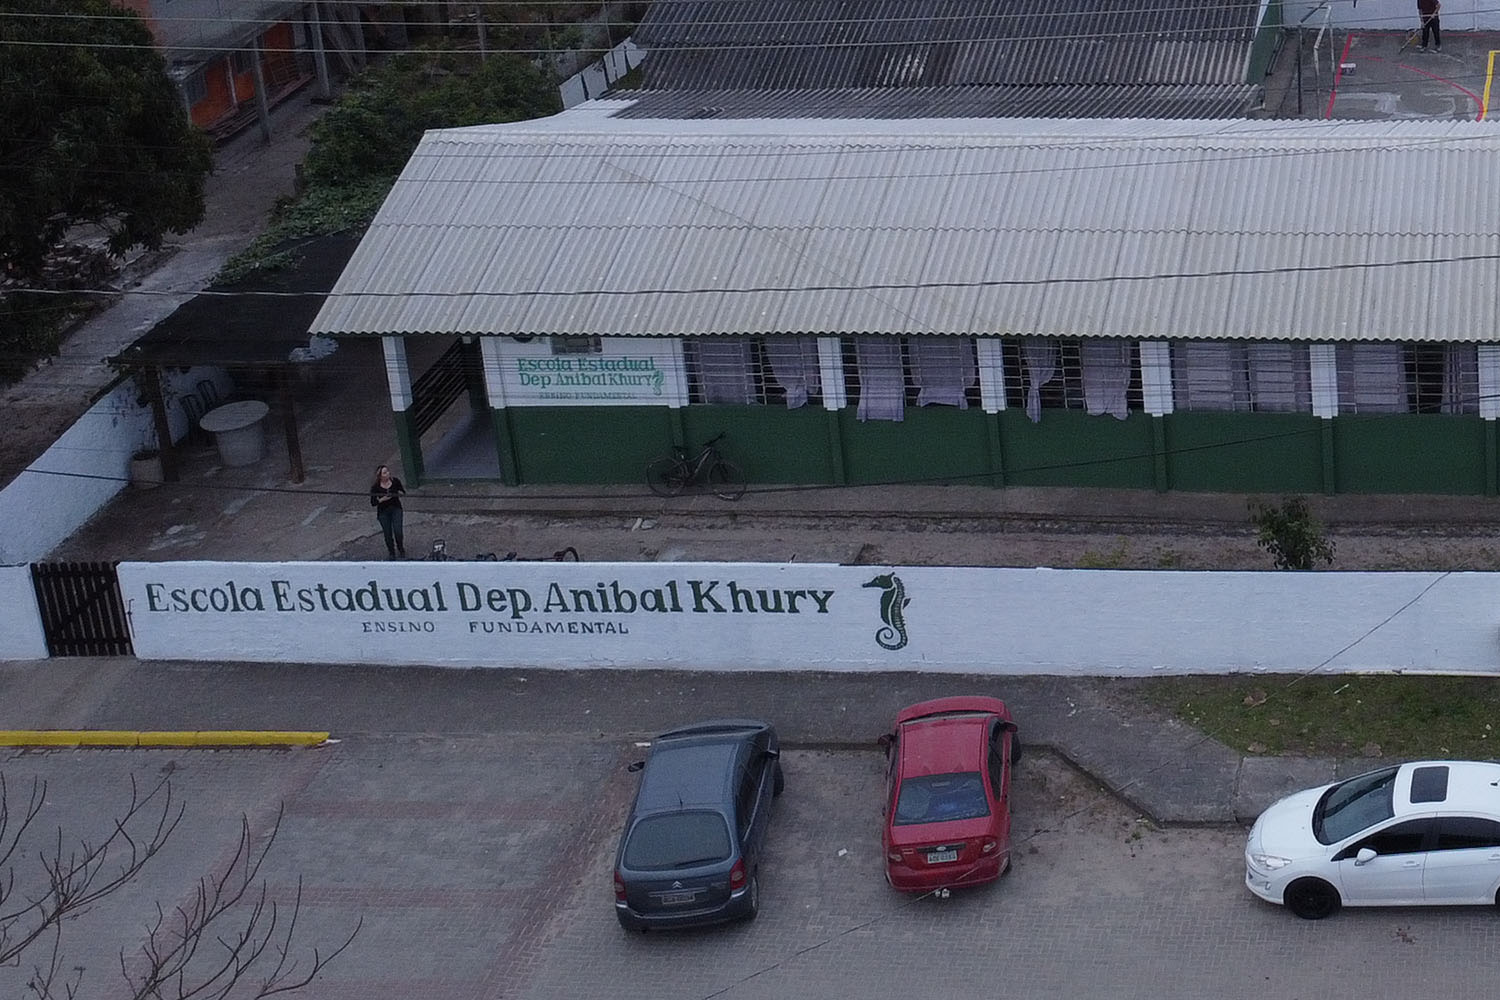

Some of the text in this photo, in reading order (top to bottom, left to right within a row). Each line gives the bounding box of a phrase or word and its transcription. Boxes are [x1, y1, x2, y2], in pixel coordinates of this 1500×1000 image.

[517, 356, 655, 372] Escola Estadual
[556, 372, 606, 386] Anibal
[609, 373, 651, 386] Khury
[146, 580, 835, 619] Escola Estadual Dep. Anibal Khury
[361, 621, 630, 635] ENSINO FUNDAMENTAL
